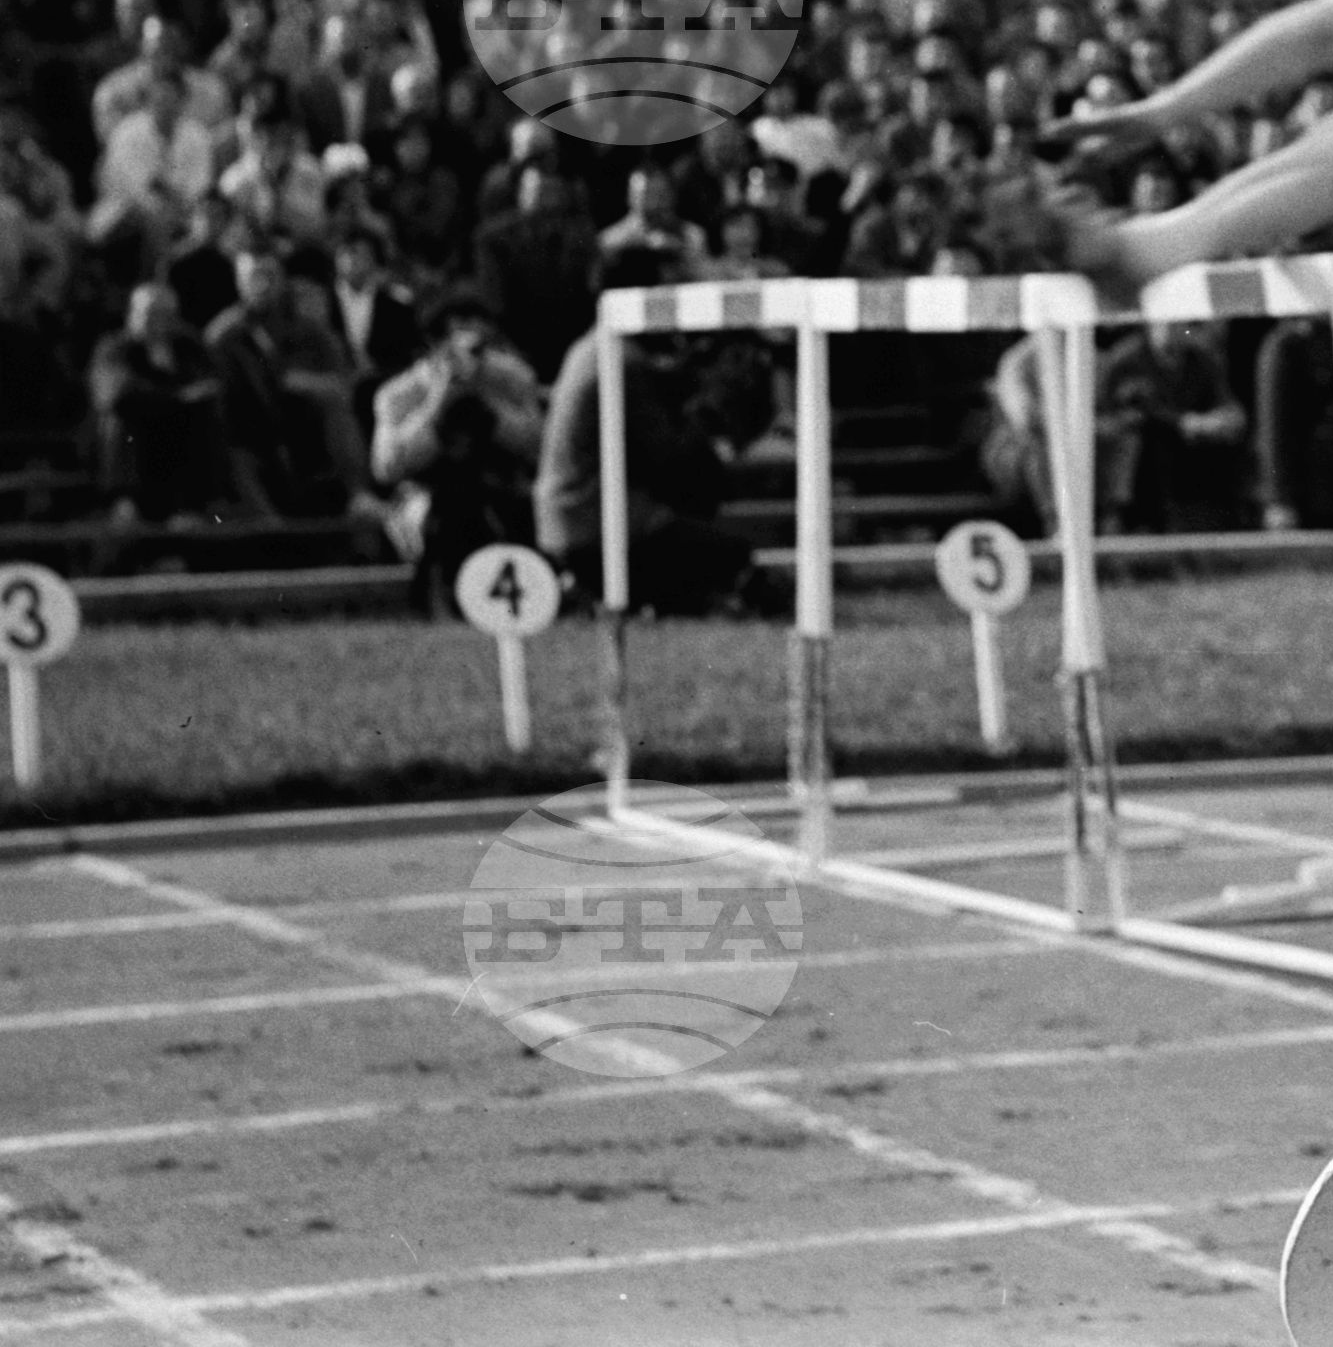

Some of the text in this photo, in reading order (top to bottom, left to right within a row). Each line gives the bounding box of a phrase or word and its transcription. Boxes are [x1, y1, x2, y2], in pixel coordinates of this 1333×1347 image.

[488, 560, 525, 618] 4
[970, 534, 1005, 593] 5
[2, 579, 47, 651] 3
